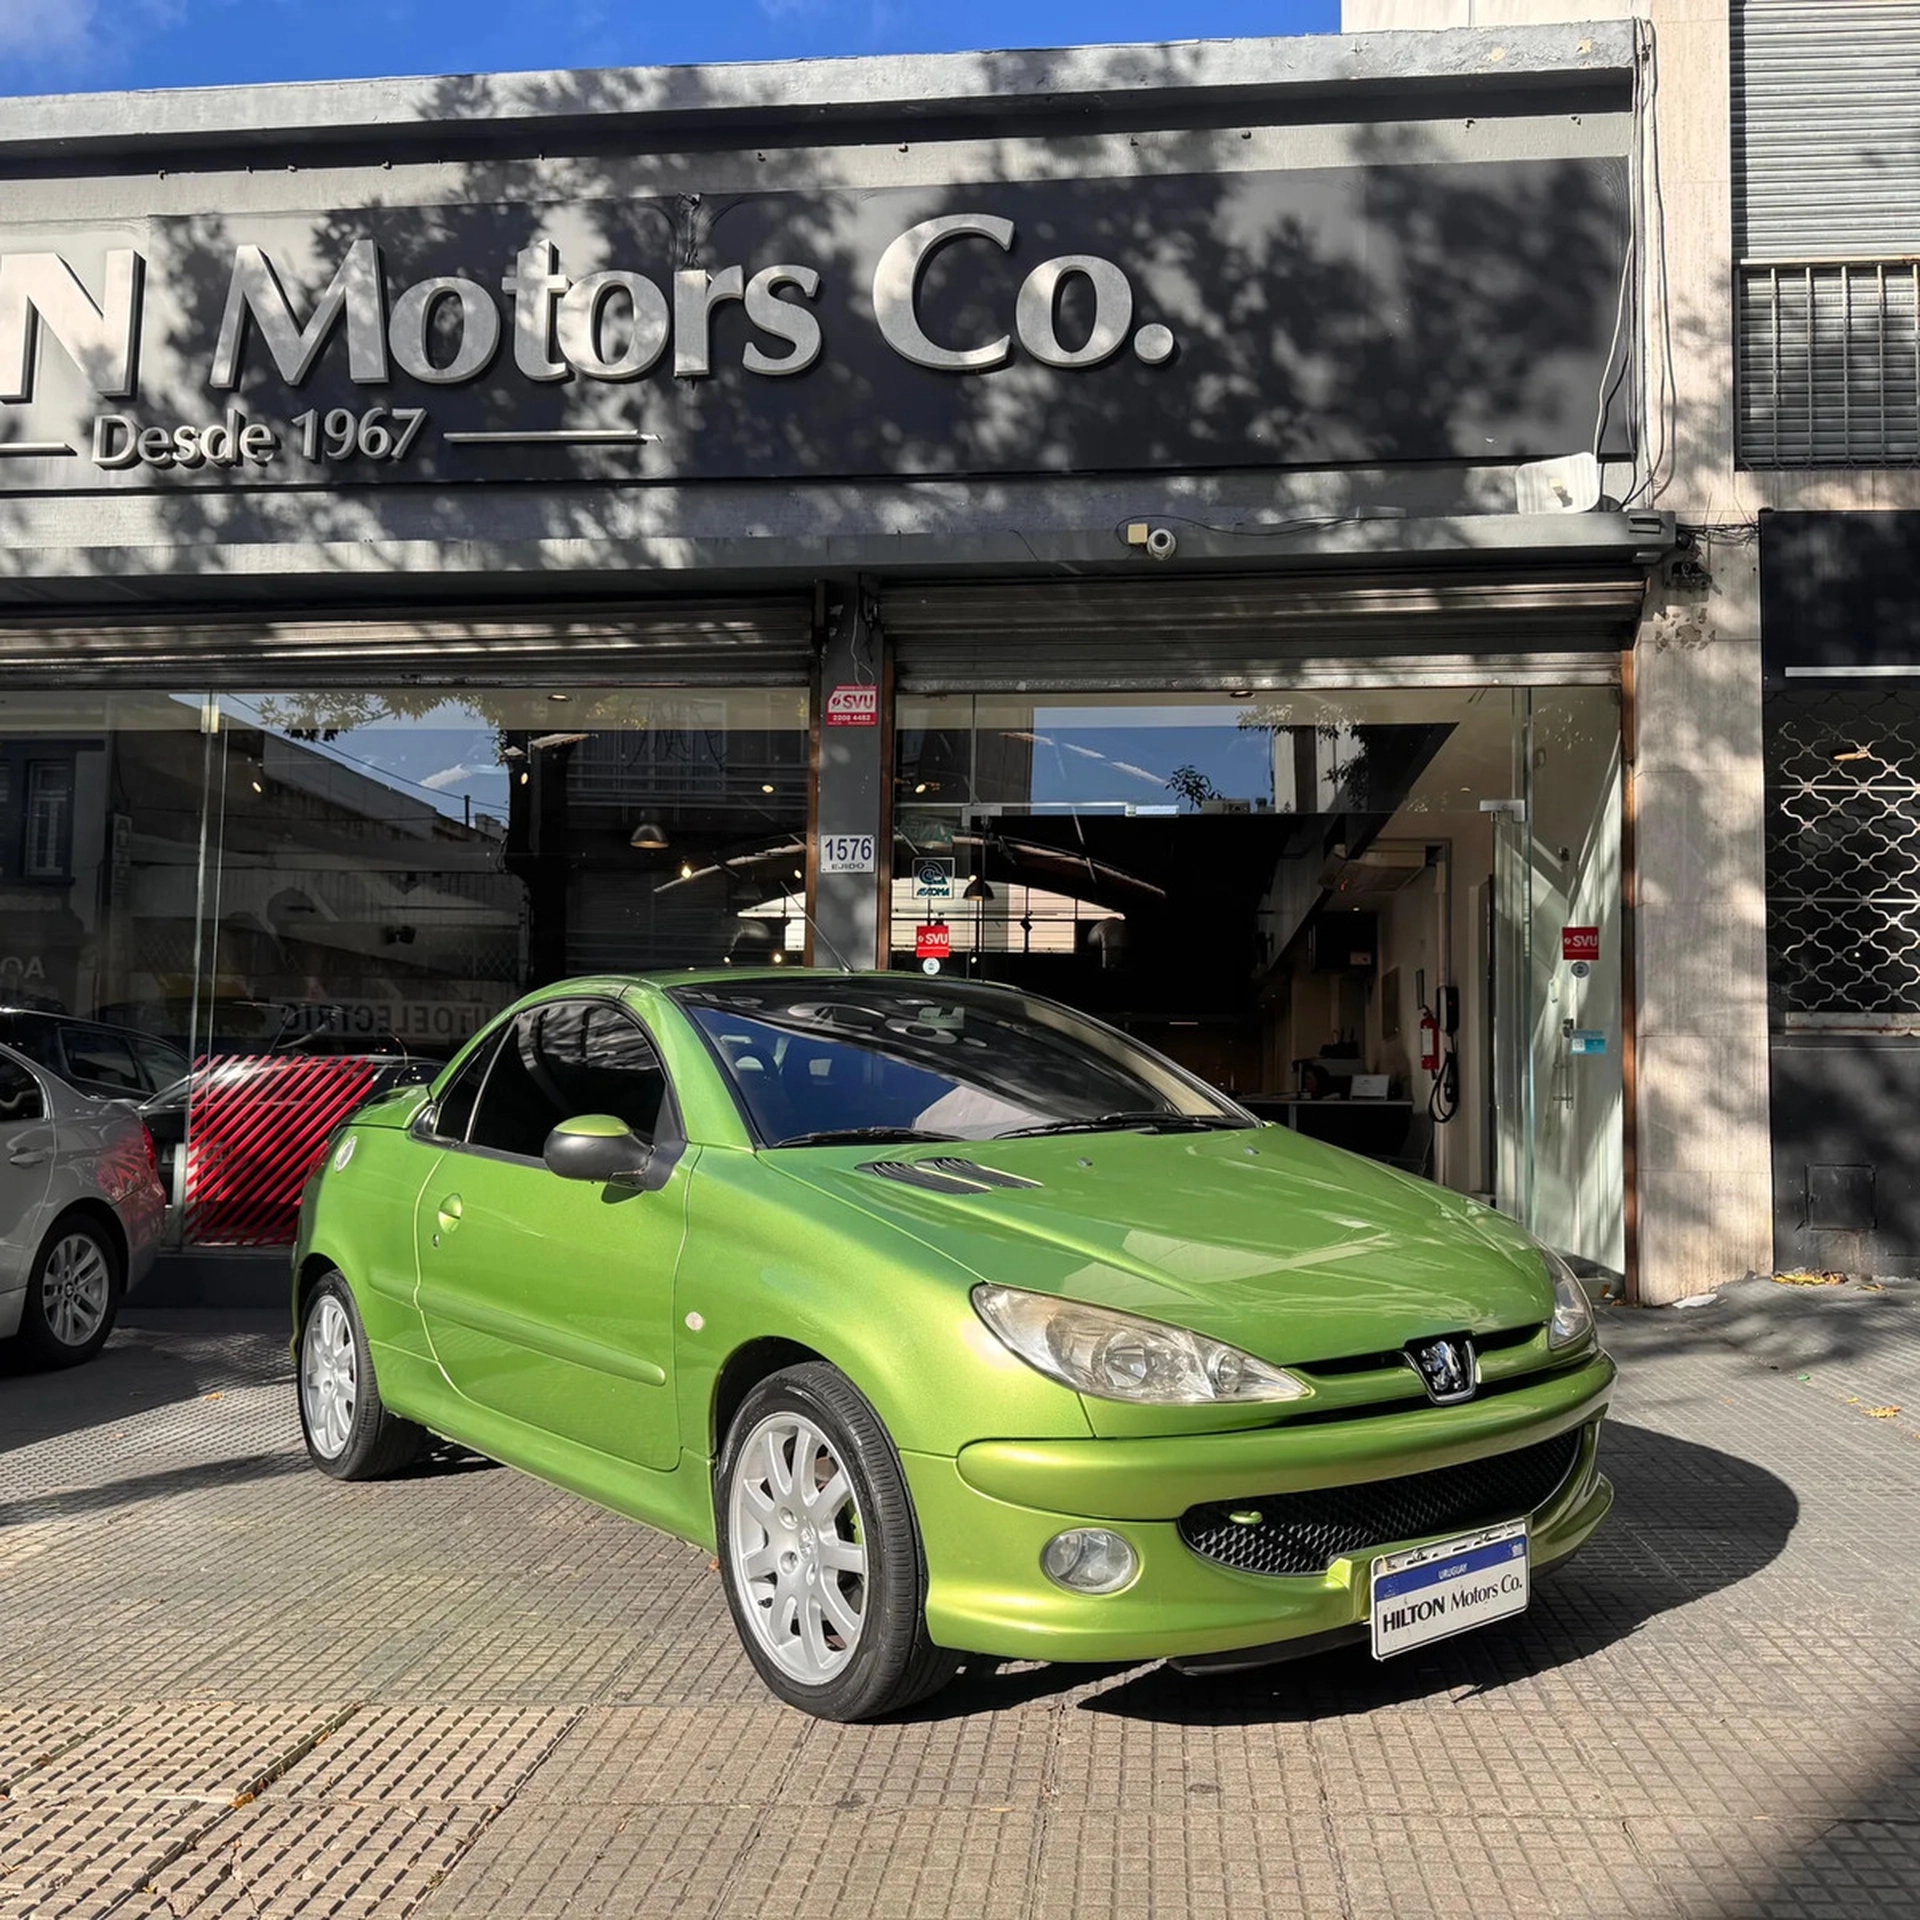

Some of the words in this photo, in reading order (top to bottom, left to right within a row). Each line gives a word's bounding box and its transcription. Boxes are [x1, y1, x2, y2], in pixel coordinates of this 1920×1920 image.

[209, 239, 822, 388] Motors
[872, 213, 1175, 370] Co.
[92, 408, 275, 467] Desde
[291, 408, 428, 460] 1967
[843, 695, 873, 708] SVU
[825, 838, 871, 860] 1576
[925, 933, 948, 944] SVU
[1572, 935, 1598, 947] SVU
[1438, 1563, 1468, 1579] URUGUAY
[1383, 1596, 1446, 1633] HILTON
[1450, 1583, 1499, 1611] Motors
[1501, 1574, 1523, 1594] Co.
